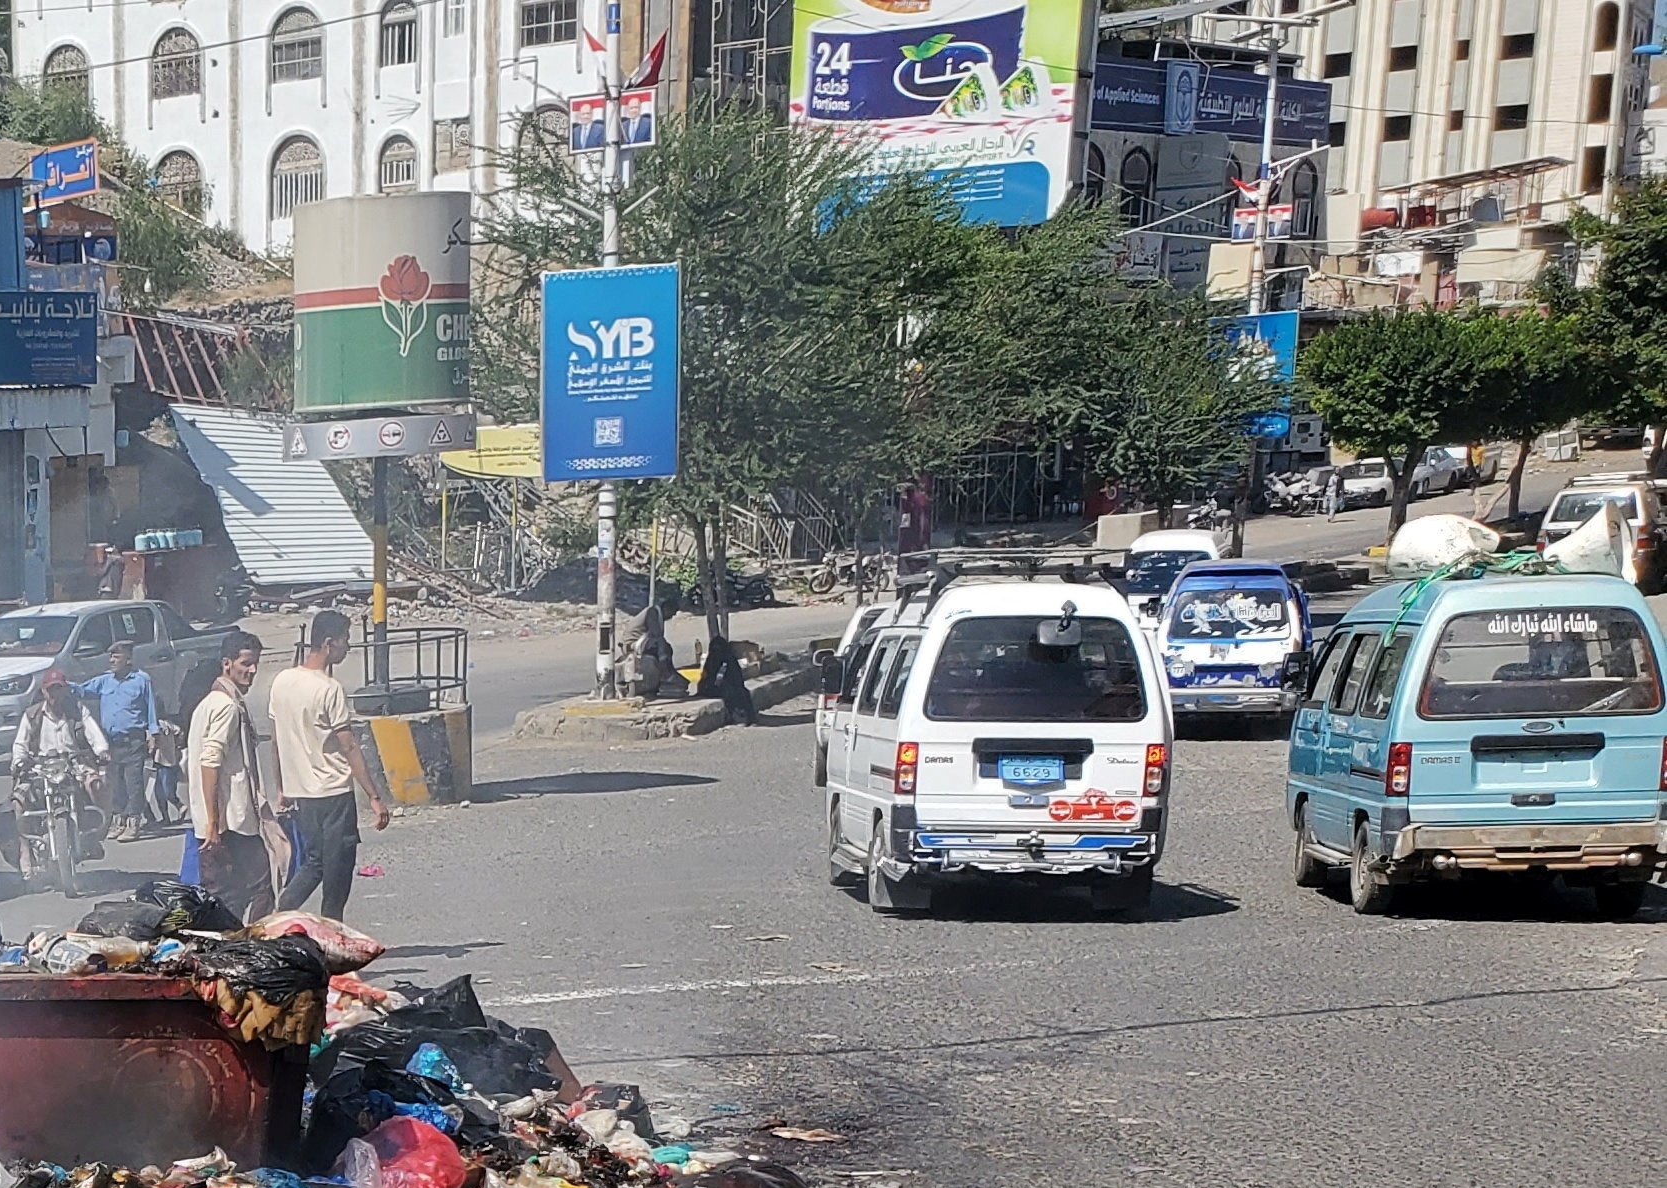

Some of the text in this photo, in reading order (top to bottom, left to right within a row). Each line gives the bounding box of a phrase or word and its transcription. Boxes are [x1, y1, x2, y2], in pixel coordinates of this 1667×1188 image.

[815, 42, 853, 76] 24
[811, 96, 851, 113] Portions
[1097, 89, 1161, 106] of Applied Sciences
[44, 295, 95, 324] ثلاجة
[1487, 613, 1510, 633] الله
[1540, 612, 1563, 633] الله
[1563, 612, 1598, 633] ماشاء
[924, 756, 954, 765] DAMAS
[1420, 756, 1454, 765] DAMAS
[1012, 767, 1051, 778] 6629
